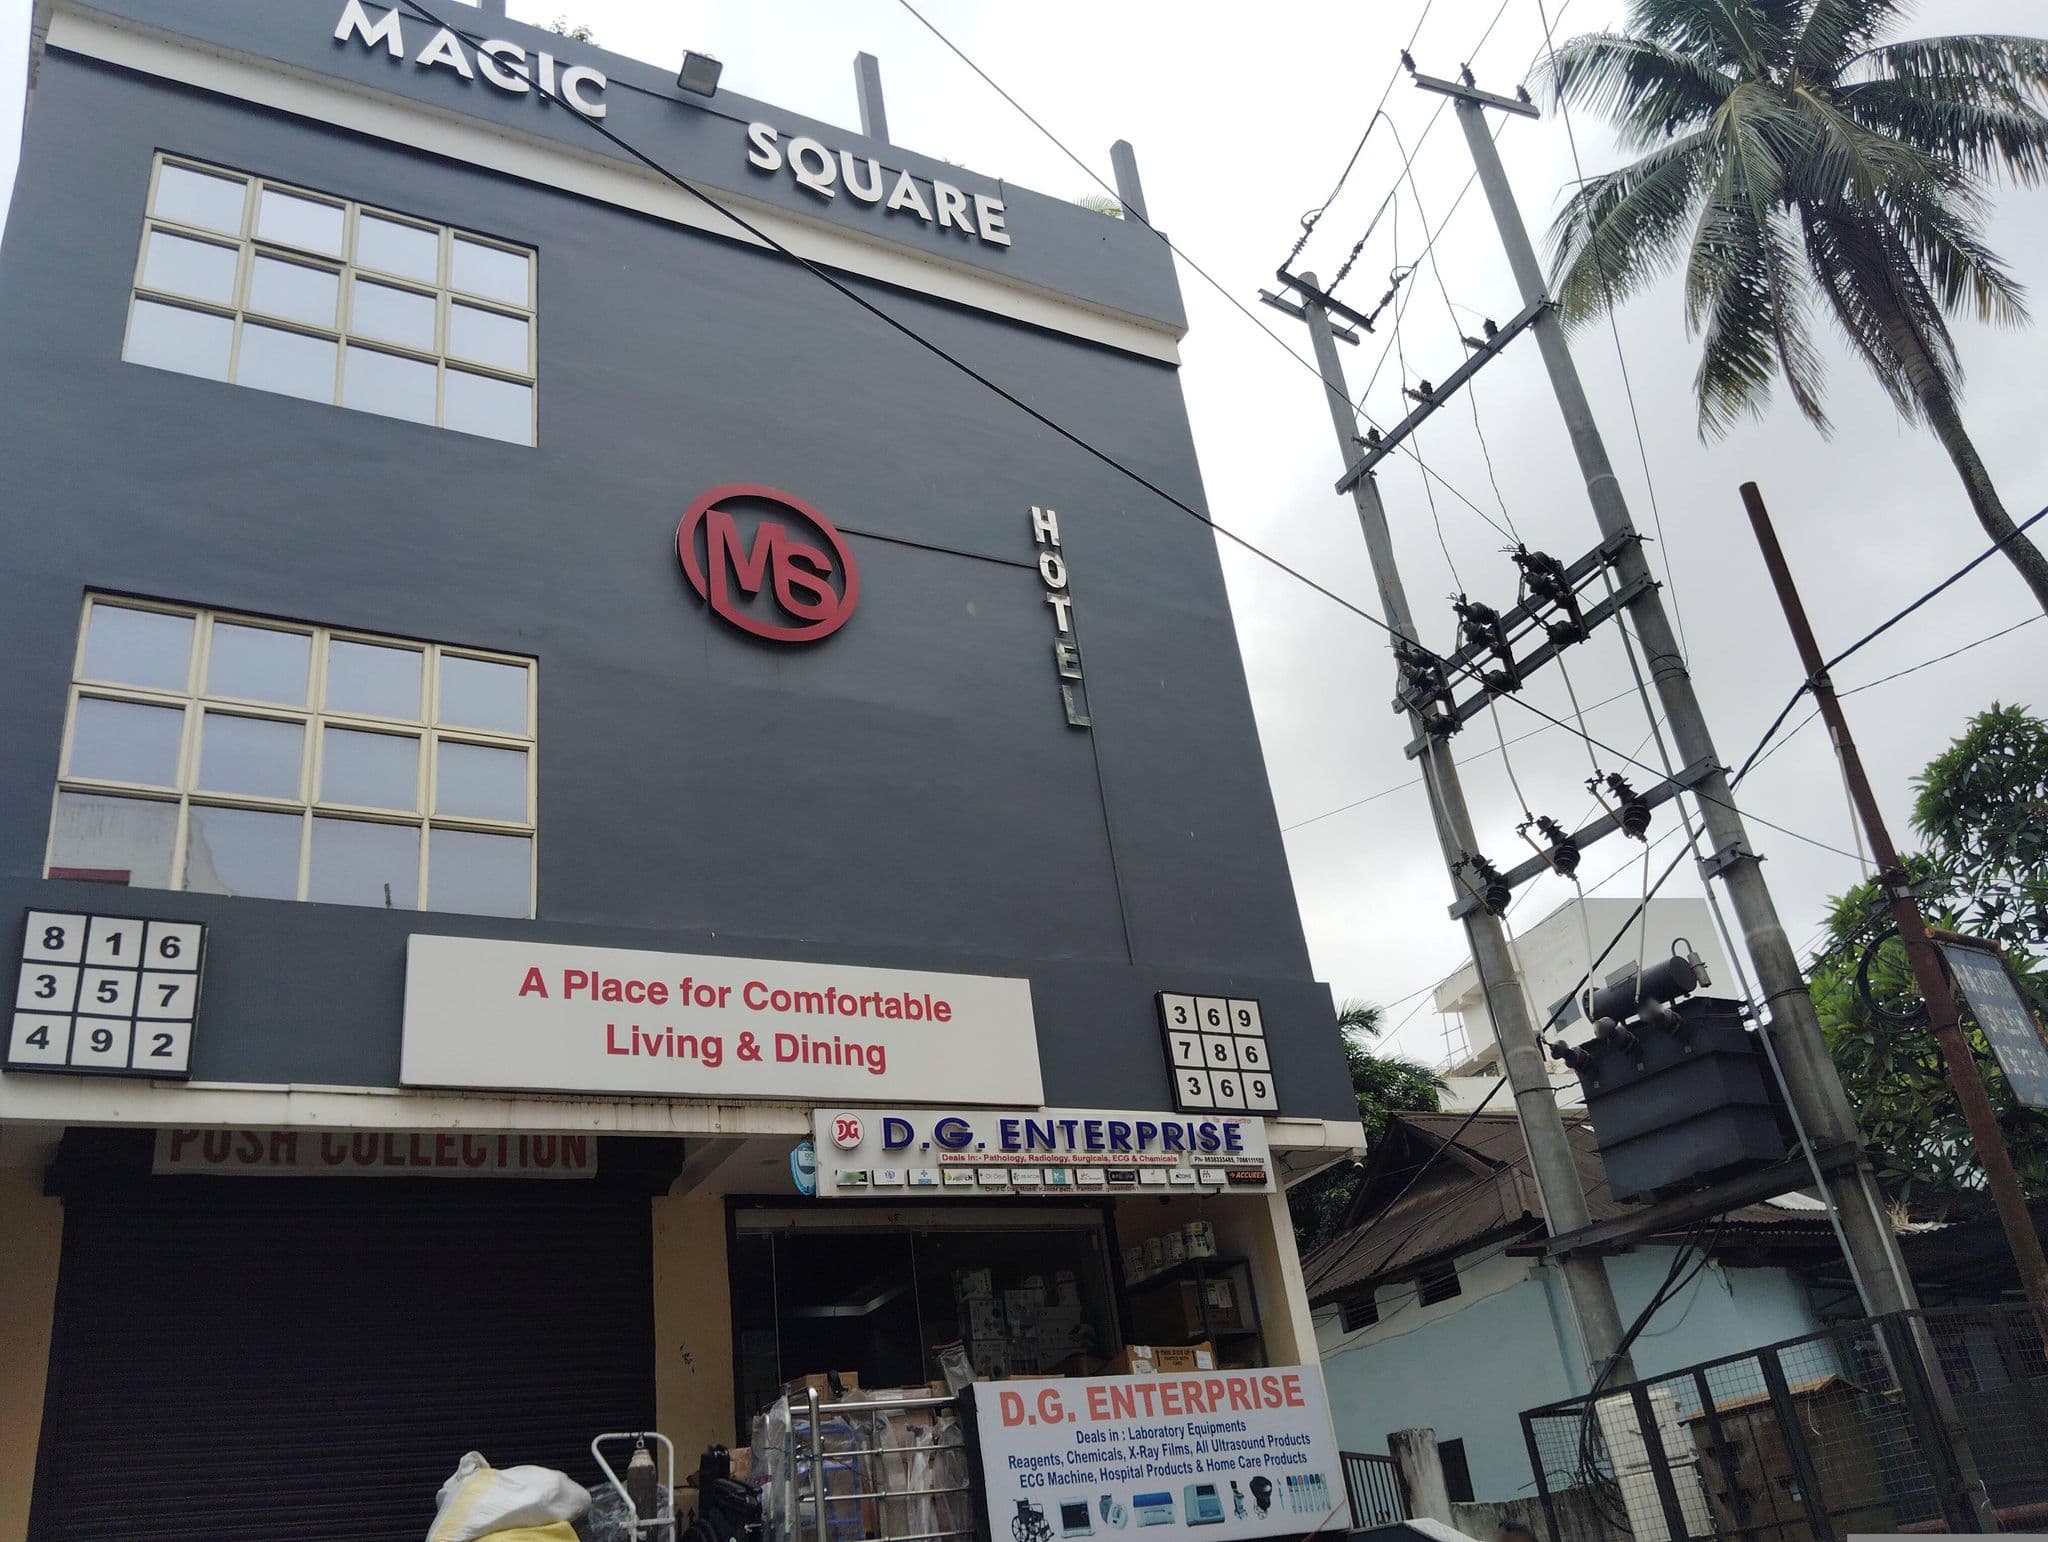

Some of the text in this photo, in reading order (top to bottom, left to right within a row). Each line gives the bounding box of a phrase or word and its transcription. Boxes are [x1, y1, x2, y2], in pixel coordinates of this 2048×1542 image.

[334, 0, 607, 118] MAGIC
[746, 121, 1012, 248] SQUARE
[1030, 505, 1092, 728] HOTEL
[42, 926, 182, 959] 8 1 6
[34, 974, 180, 1007] 3 5 7
[519, 967, 953, 1022] A Place for Comfortable
[1173, 1006, 1251, 1027] 3 6 9
[25, 1025, 173, 1057] 4 9 2
[606, 1024, 887, 1075] Living & Dining
[1178, 1041, 1258, 1064] 7 8 6
[1187, 1077, 1266, 1099] 3 6 9
[881, 1117, 1244, 1151] D.G. ENTERPRISE
[941, 1153, 966, 1162] Deals
[983, 1154, 1027, 1164] Pathology,
[1028, 1154, 1070, 1164] Radiology,
[1072, 1154, 1111, 1164] Surgicals,
[1112, 1154, 1130, 1163] ECG
[1131, 1154, 1138, 1163] &
[1138, 1154, 1178, 1164] Chemicals
[1234, 1171, 1265, 1179] ACCUREX
[999, 1374, 1305, 1427] D.G. ENTERPRISE
[1076, 1430, 1107, 1444] Deals
[1109, 1428, 1120, 1442] in
[1128, 1425, 1185, 1441] Laboratory
[1187, 1420, 1247, 1437] Equipments
[1008, 1432, 1311, 1471] Reagents, Chemicals, X-Ray Films, All Ultrasound Products
[1019, 1451, 1308, 1489] ECG Machine, Hospital Products & Home Care Products
